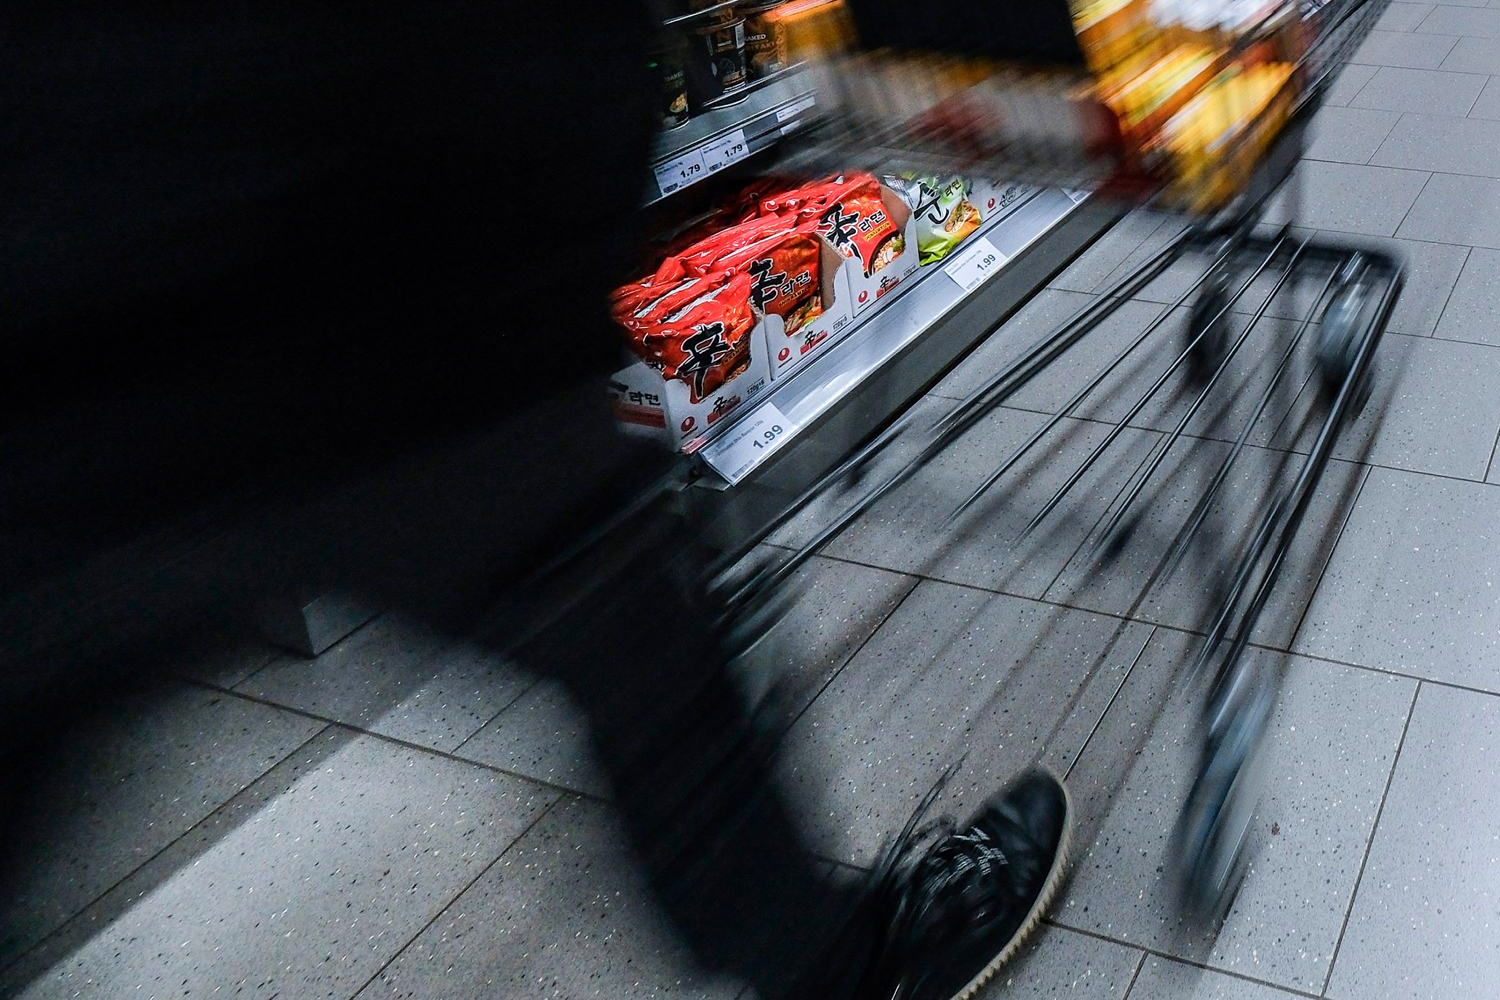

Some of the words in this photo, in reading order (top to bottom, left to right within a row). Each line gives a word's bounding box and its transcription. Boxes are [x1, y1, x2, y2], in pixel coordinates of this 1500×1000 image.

[723, 143, 744, 158] 1.79
[680, 163, 701, 179] 1.79
[857, 209, 887, 233] 라면
[976, 253, 997, 272] 1.99
[780, 269, 813, 297] 라면
[628, 391, 662, 406] 라면
[752, 423, 785, 451] 1.99
